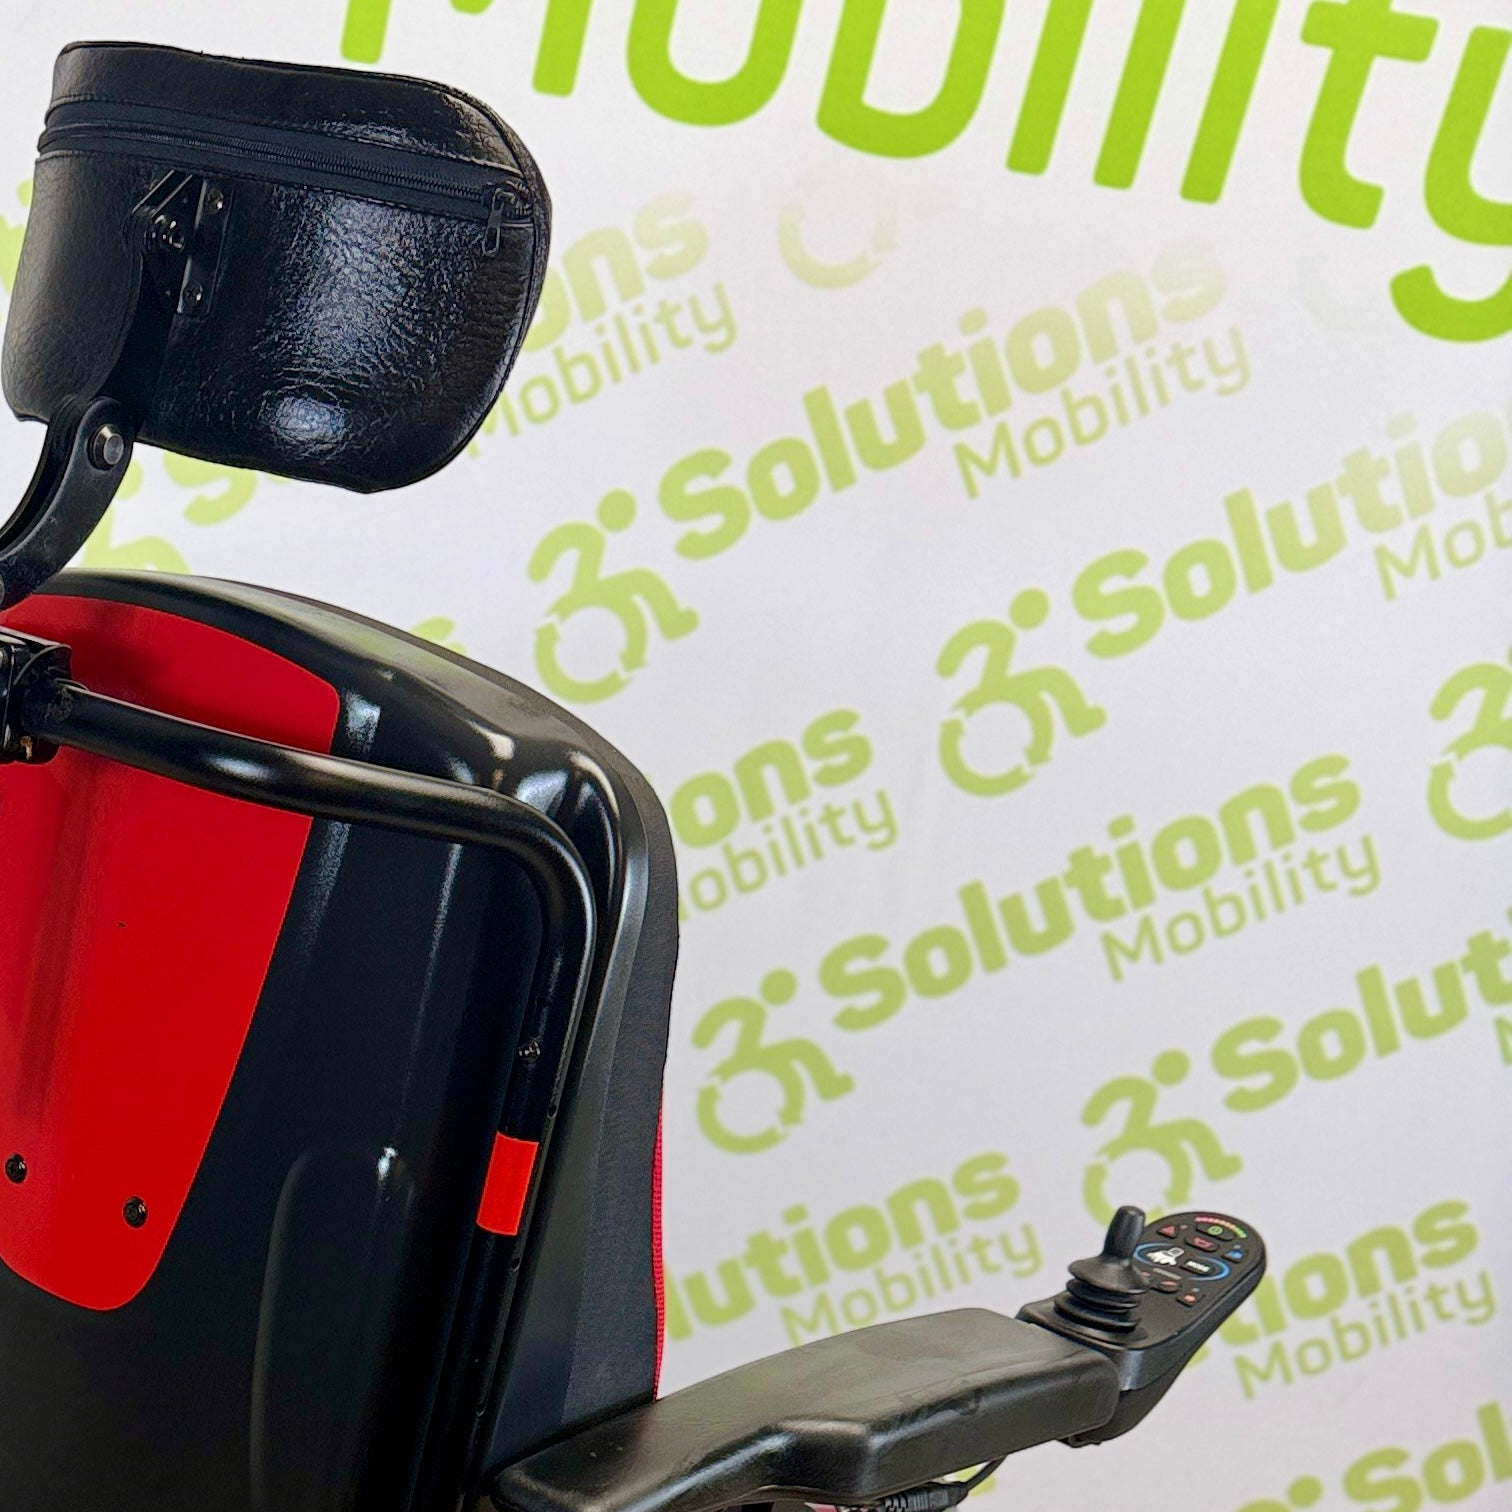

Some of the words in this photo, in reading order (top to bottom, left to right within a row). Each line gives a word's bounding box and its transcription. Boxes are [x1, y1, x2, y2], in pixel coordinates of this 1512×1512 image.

[657, 240, 1227, 560] Solutions
[952, 325, 1252, 500] Mobility
[678, 788, 899, 923] obility
[817, 753, 1362, 1032] Solutions
[1101, 833, 1383, 982] Mobility
[1211, 905, 1512, 1114] Solut
[780, 1223, 1044, 1348] Mobility
[1234, 1271, 1497, 1400] Mobility
